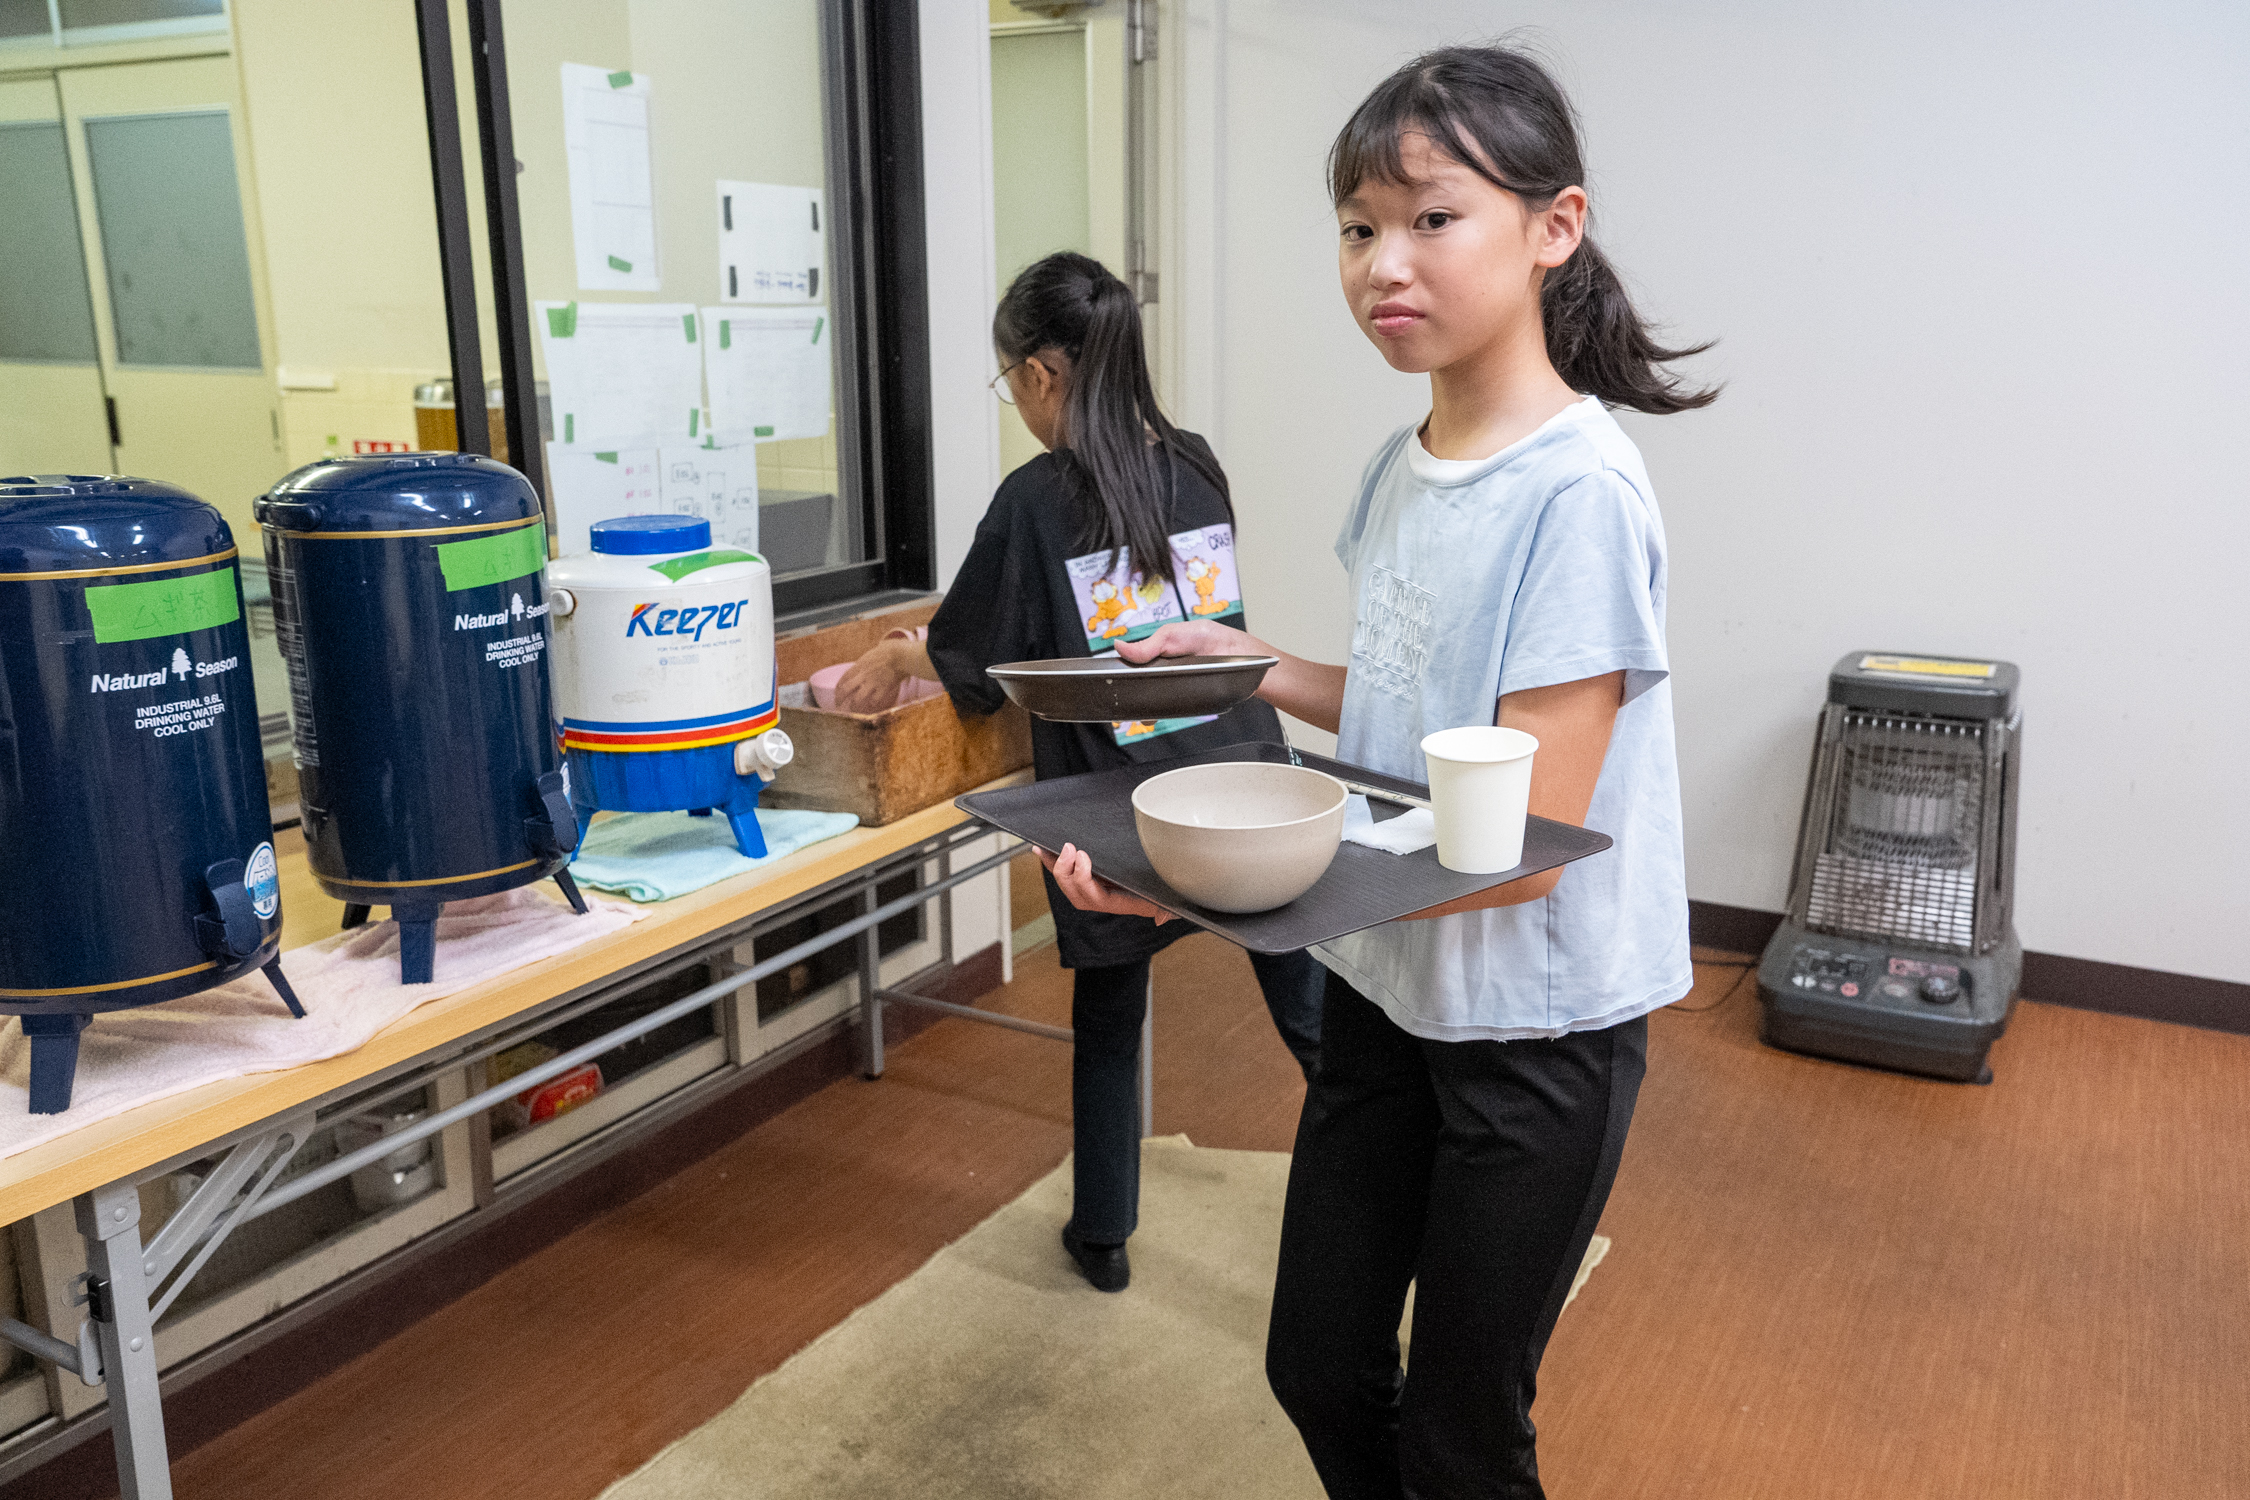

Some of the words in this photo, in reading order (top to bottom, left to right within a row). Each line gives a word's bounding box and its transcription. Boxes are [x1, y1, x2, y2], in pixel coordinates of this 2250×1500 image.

[1368, 572, 1432, 626] CAPRICE
[454, 609, 509, 631] Natural
[626, 599, 749, 642] Keeper
[1367, 600, 1387, 628] OF
[1394, 611, 1424, 649] THE
[486, 647, 525, 662] DRINKING
[525, 641, 545, 653] WATER
[487, 637, 532, 652] INDUSTRIAL
[531, 632, 543, 642] 9.6L
[1357, 620, 1427, 677] MOMENT
[499, 657, 522, 668] COOL
[522, 652, 540, 664] ONLY
[91, 667, 168, 693] Natural
[195, 656, 238, 678] Season
[135, 711, 192, 730] DRINKING
[193, 703, 226, 719] WATER
[136, 698, 203, 718] INDUSTRIAL
[203, 693, 222, 706] 9.6L
[154, 724, 188, 738] COOL
[188, 717, 216, 732] ONLY
